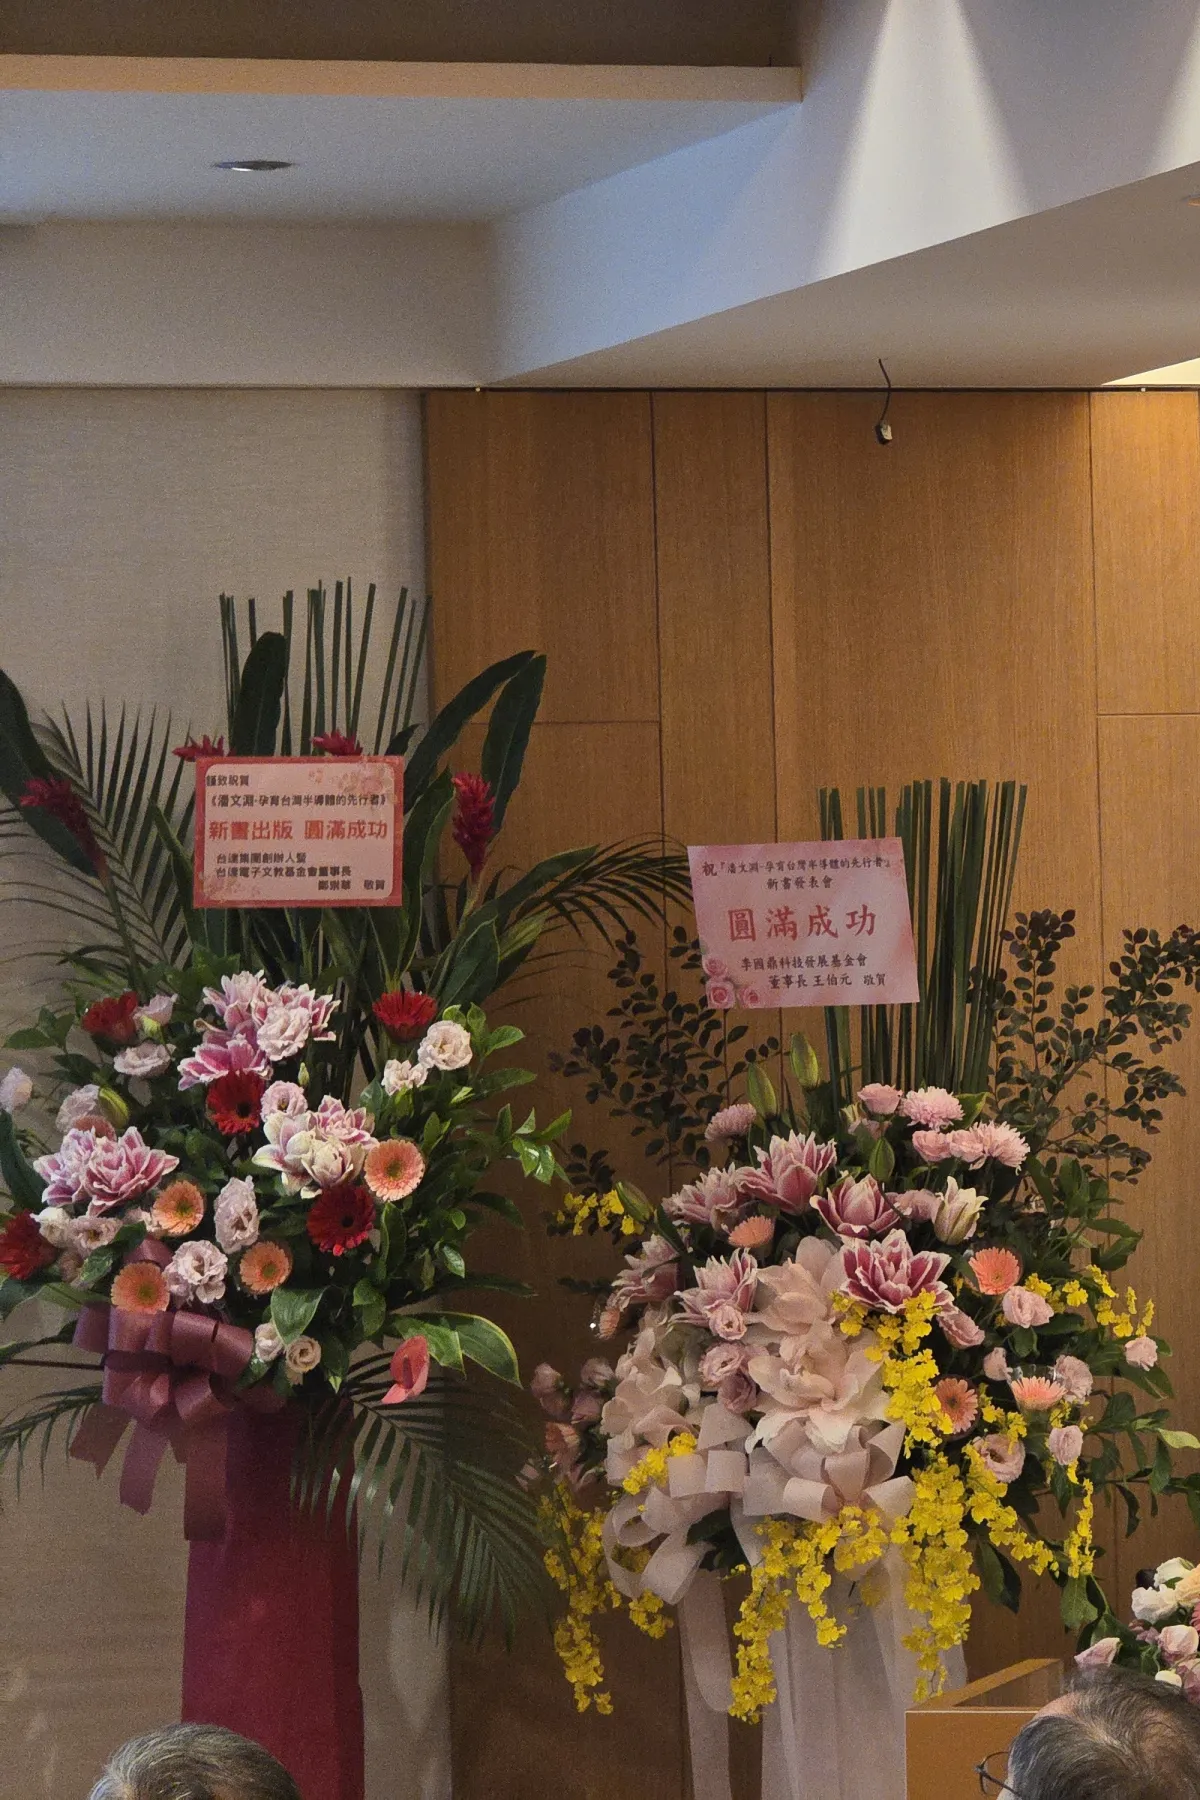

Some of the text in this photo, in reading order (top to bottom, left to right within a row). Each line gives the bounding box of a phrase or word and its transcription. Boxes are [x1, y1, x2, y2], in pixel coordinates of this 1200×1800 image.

[208, 820, 388, 841] 新書出版 圓滿成功
[766, 876, 834, 891] 新書發表會
[727, 904, 877, 942] 圓滿成功
[741, 953, 868, 970] 李國鼎科技發展基金會
